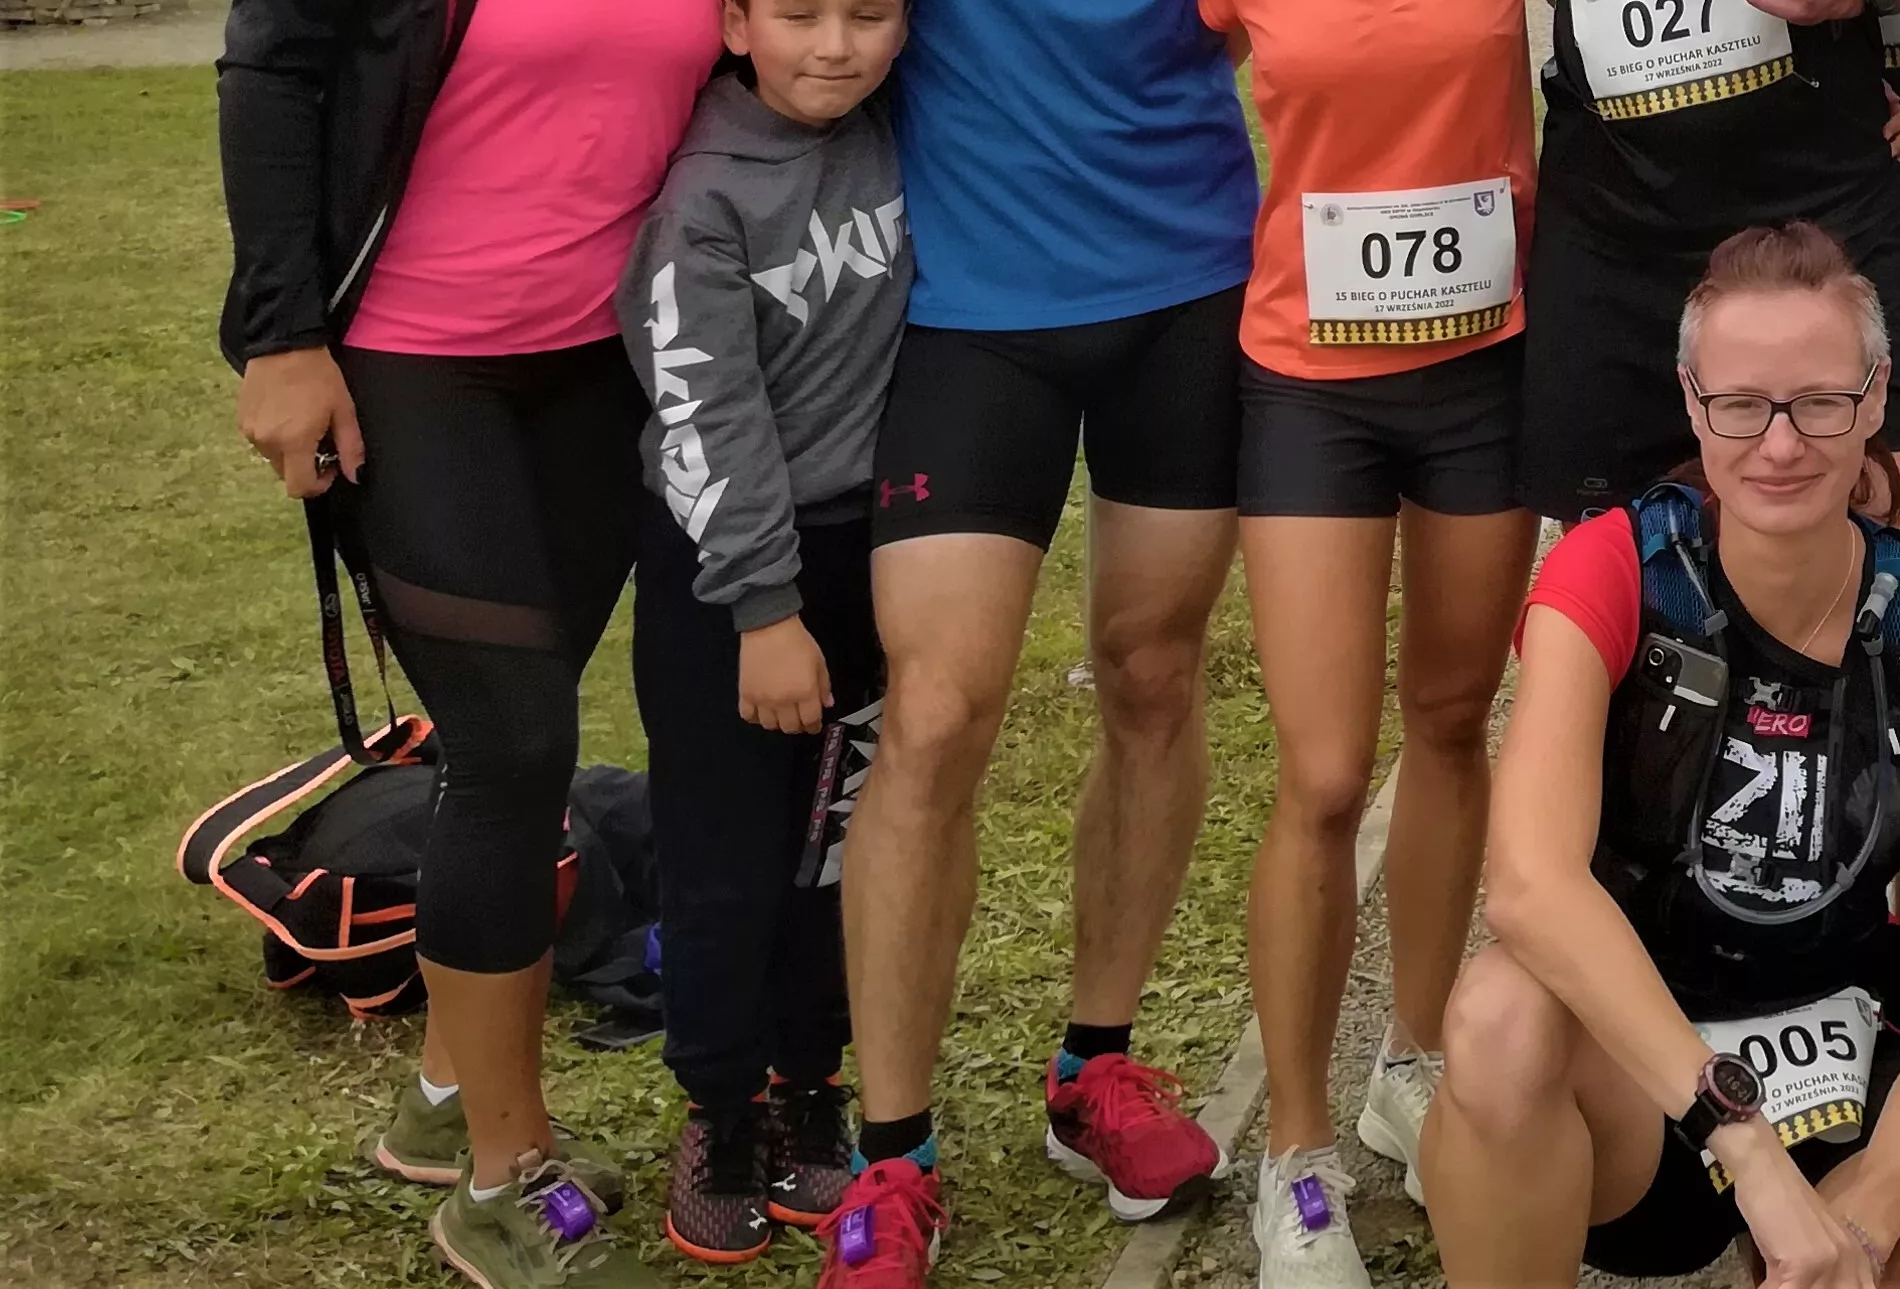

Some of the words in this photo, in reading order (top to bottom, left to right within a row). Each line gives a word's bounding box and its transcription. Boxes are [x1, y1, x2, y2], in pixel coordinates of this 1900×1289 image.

[1606, 67, 1618, 78] 15
[1620, 61, 1644, 76] BIEG
[1646, 58, 1655, 70] O
[1658, 48, 1704, 67] PUCHAR
[1706, 35, 1762, 56] KASZTELU
[1644, 73, 1654, 82] 17
[1656, 63, 1701, 80] WRZEŚNIA
[1703, 58, 1723, 71] 2022
[1361, 226, 1462, 279] 078
[1335, 292, 1347, 301] 15
[1350, 291, 1375, 301] BIEG
[1378, 290, 1387, 300] O
[1390, 287, 1437, 301] PUCHAR
[1441, 279, 1492, 295] KASZTELU
[1375, 304, 1384, 312] 17
[1387, 301, 1433, 312] WRZEŚNIA
[1435, 299, 1455, 308] 2022
[1739, 1020, 1857, 1079] 005
[1771, 1087, 1782, 1099] O
[1785, 1072, 1839, 1094] PUCHAR
[1771, 1102, 1783, 1113] 17
[1784, 1086, 1838, 1107] WRZEŚNIA
[1840, 1083, 1860, 1095] 2022
